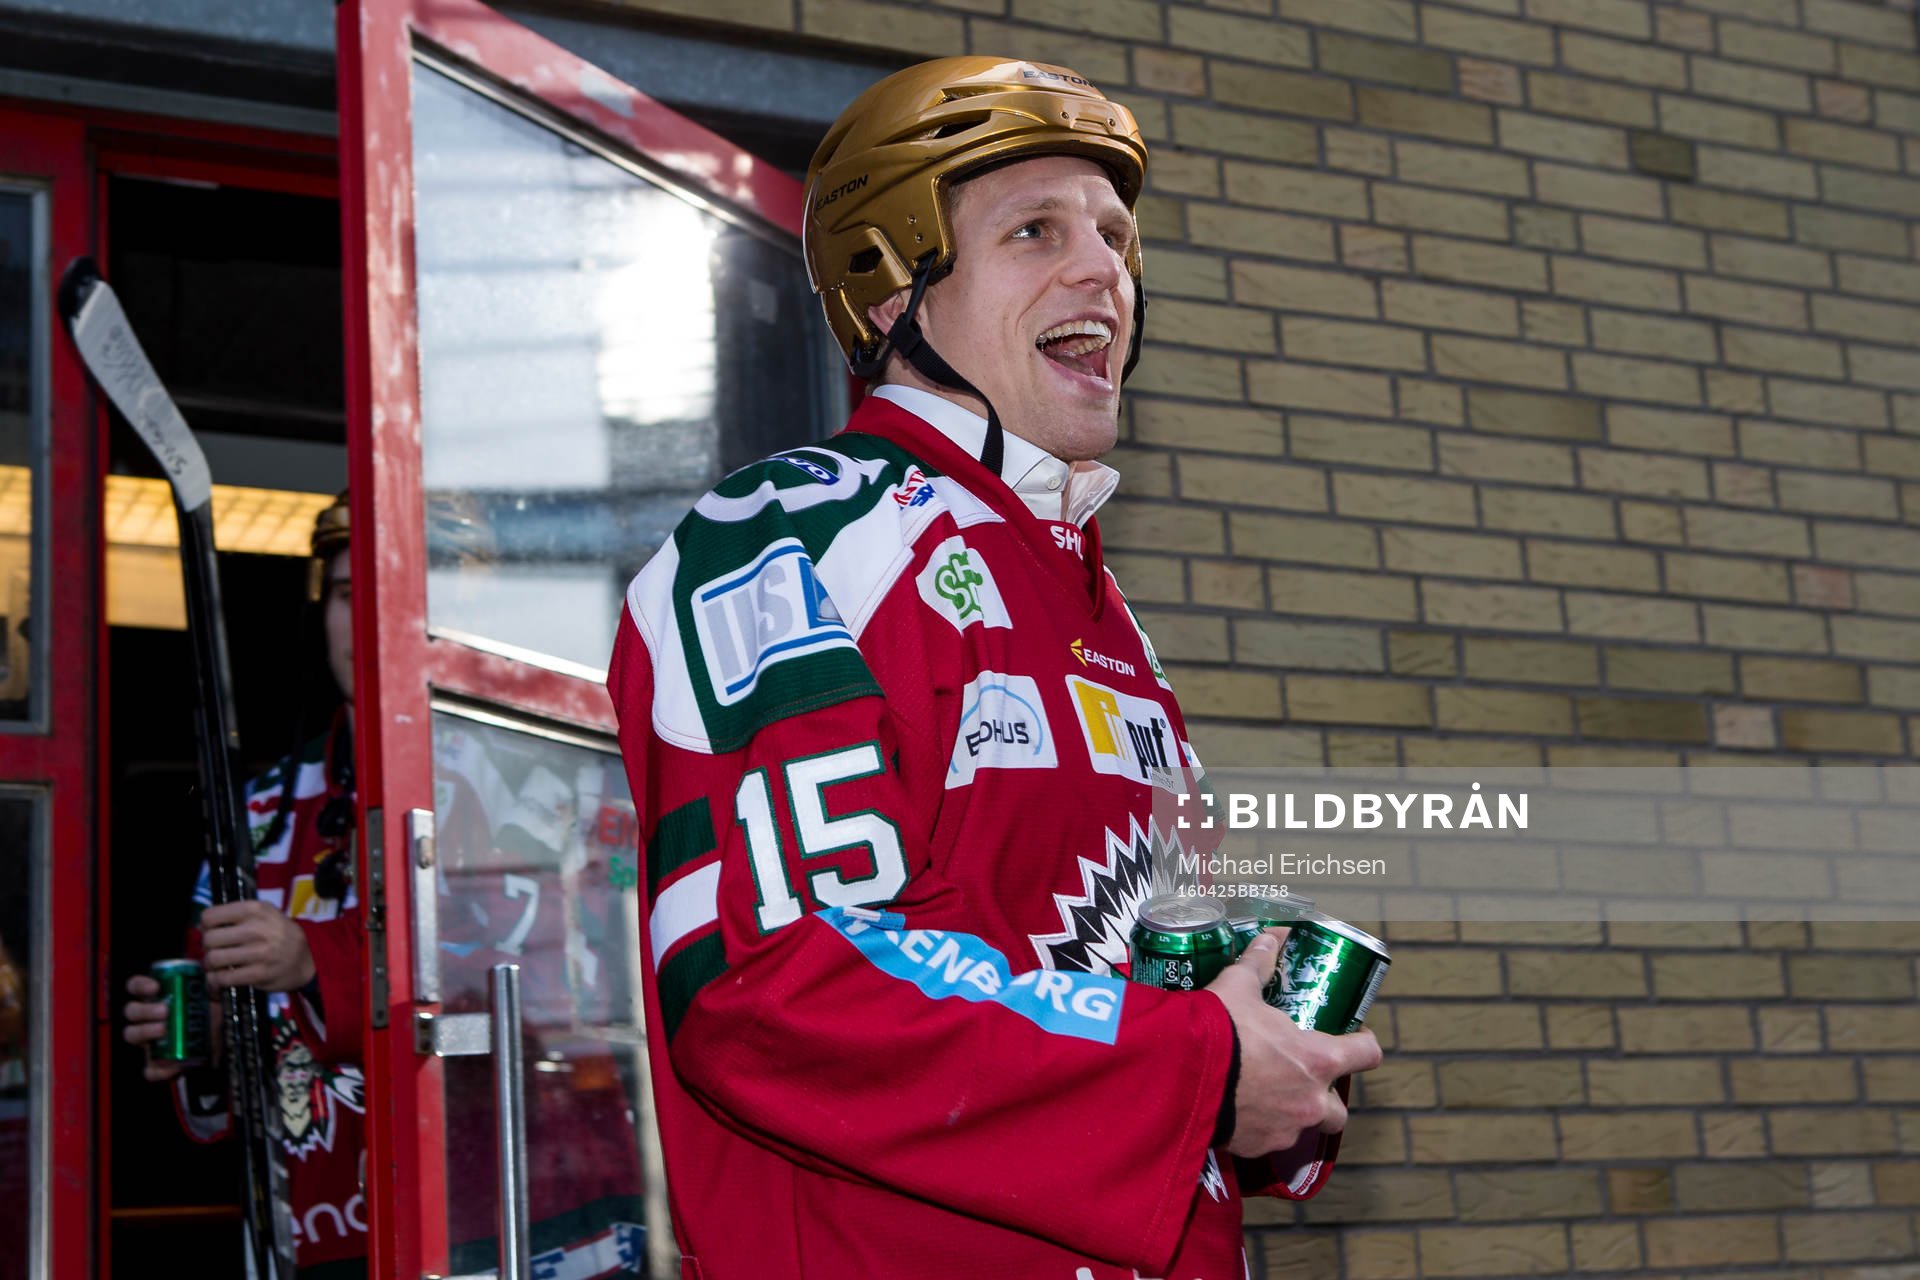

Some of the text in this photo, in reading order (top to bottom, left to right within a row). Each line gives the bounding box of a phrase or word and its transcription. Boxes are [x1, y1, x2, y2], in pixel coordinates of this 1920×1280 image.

[816, 173, 869, 212] EASTON
[1050, 525, 1084, 561] SHL
[1083, 647, 1136, 677] EASTON
[733, 739, 911, 937] 15
